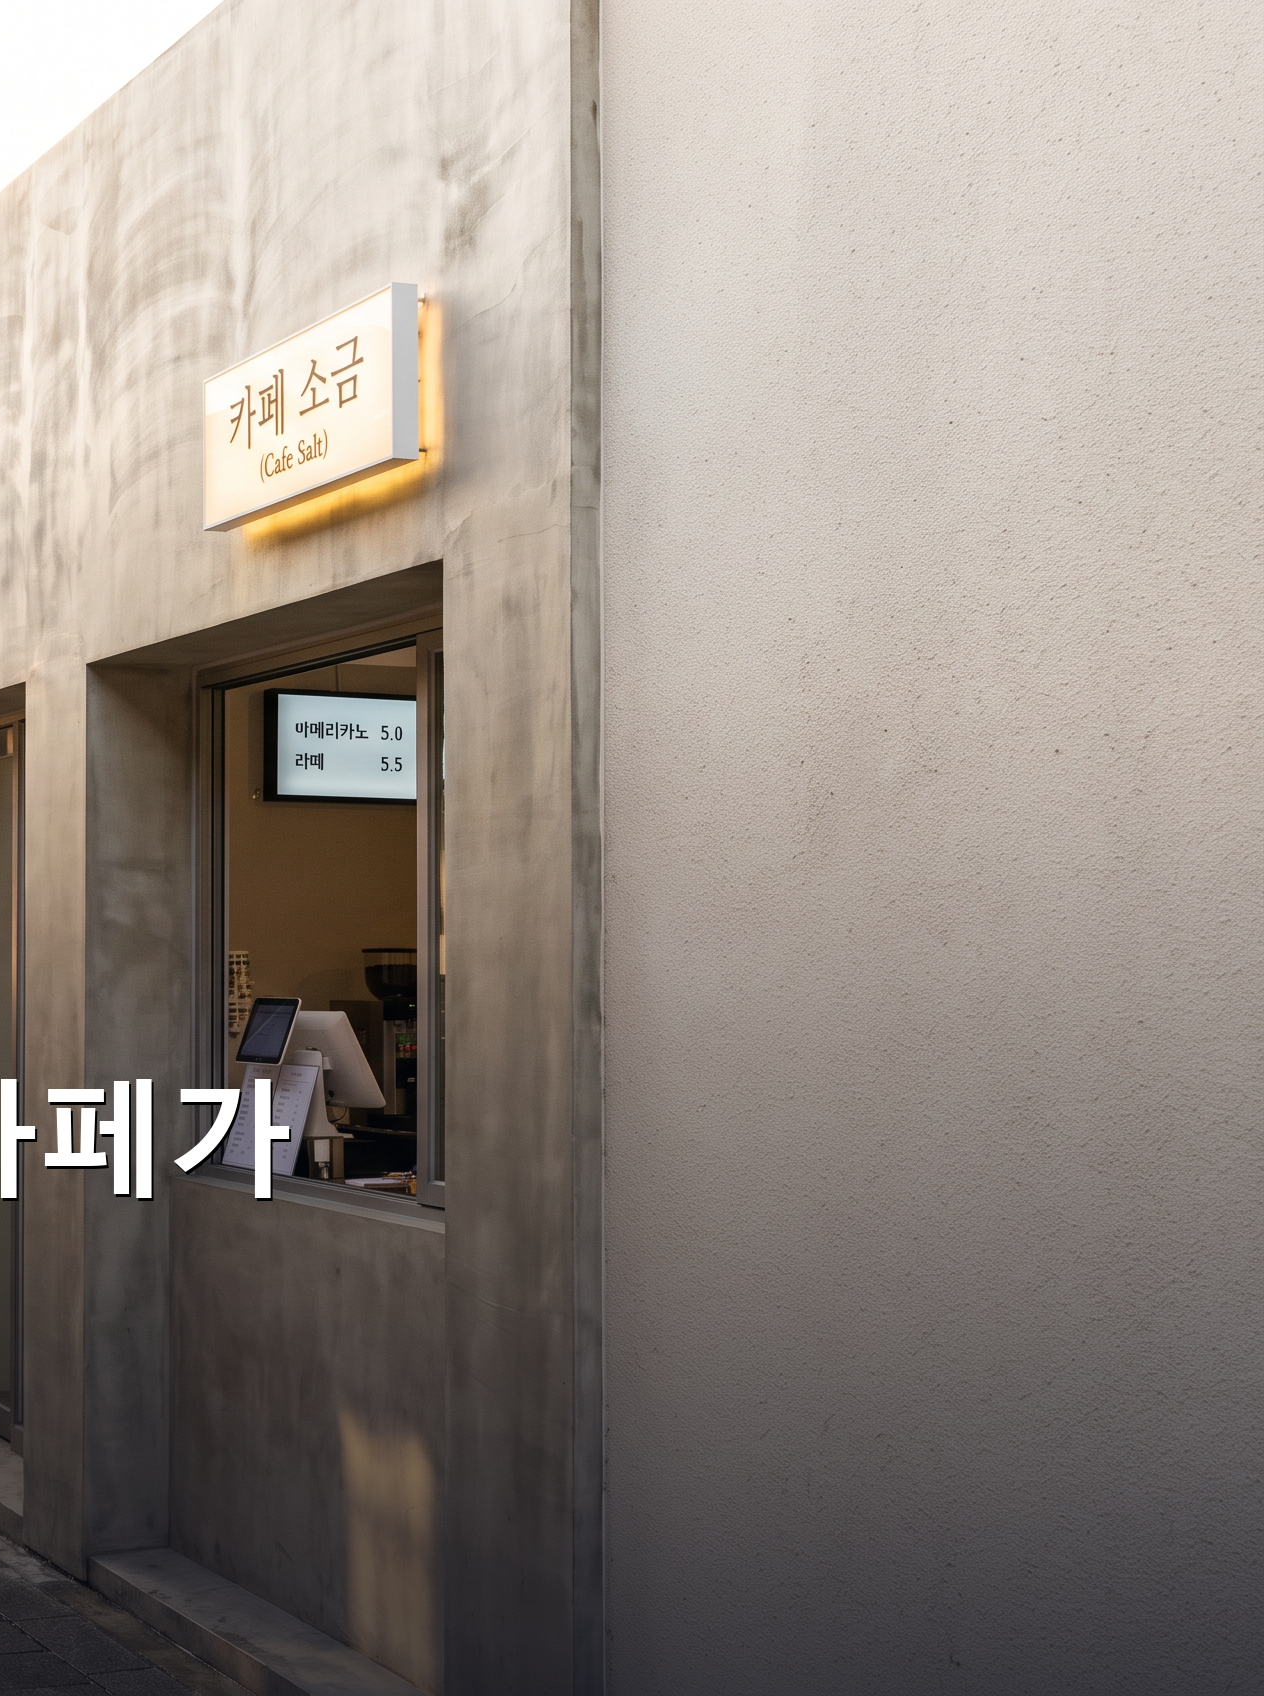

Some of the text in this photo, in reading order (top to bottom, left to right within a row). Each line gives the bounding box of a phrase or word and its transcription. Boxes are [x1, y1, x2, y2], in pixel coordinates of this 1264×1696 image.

[229, 335, 364, 450] 카페 소금
[259, 428, 329, 484] (Cafe Salt)
[295, 721, 403, 741] 아메리카노 5.0
[295, 752, 403, 772] 라떼 5.5
